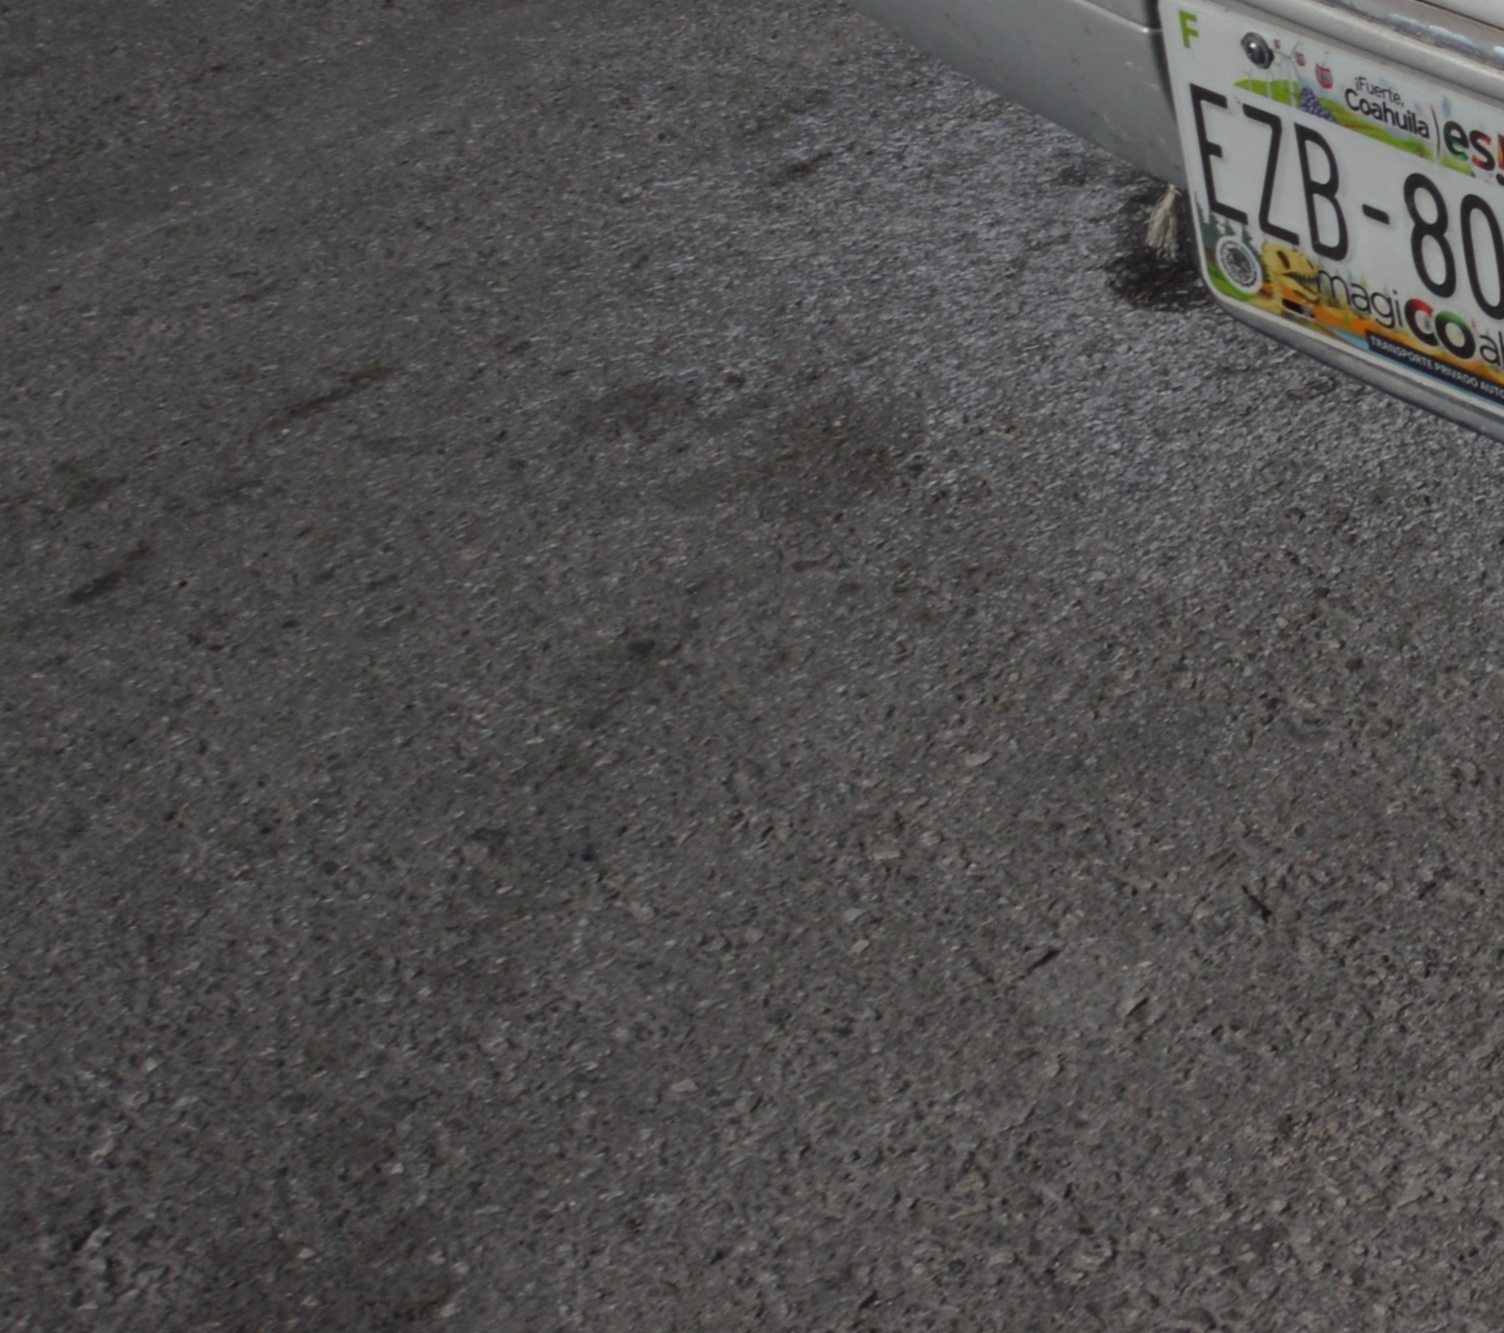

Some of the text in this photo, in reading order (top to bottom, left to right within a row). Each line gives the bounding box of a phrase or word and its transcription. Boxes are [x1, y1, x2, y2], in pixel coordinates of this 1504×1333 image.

[1178, 10, 1199, 49] F
[1344, 88, 1430, 139] Coahuila
[1370, 336, 1434, 368] TRANSPORTE
[1434, 362, 1479, 388] PRIVADO
